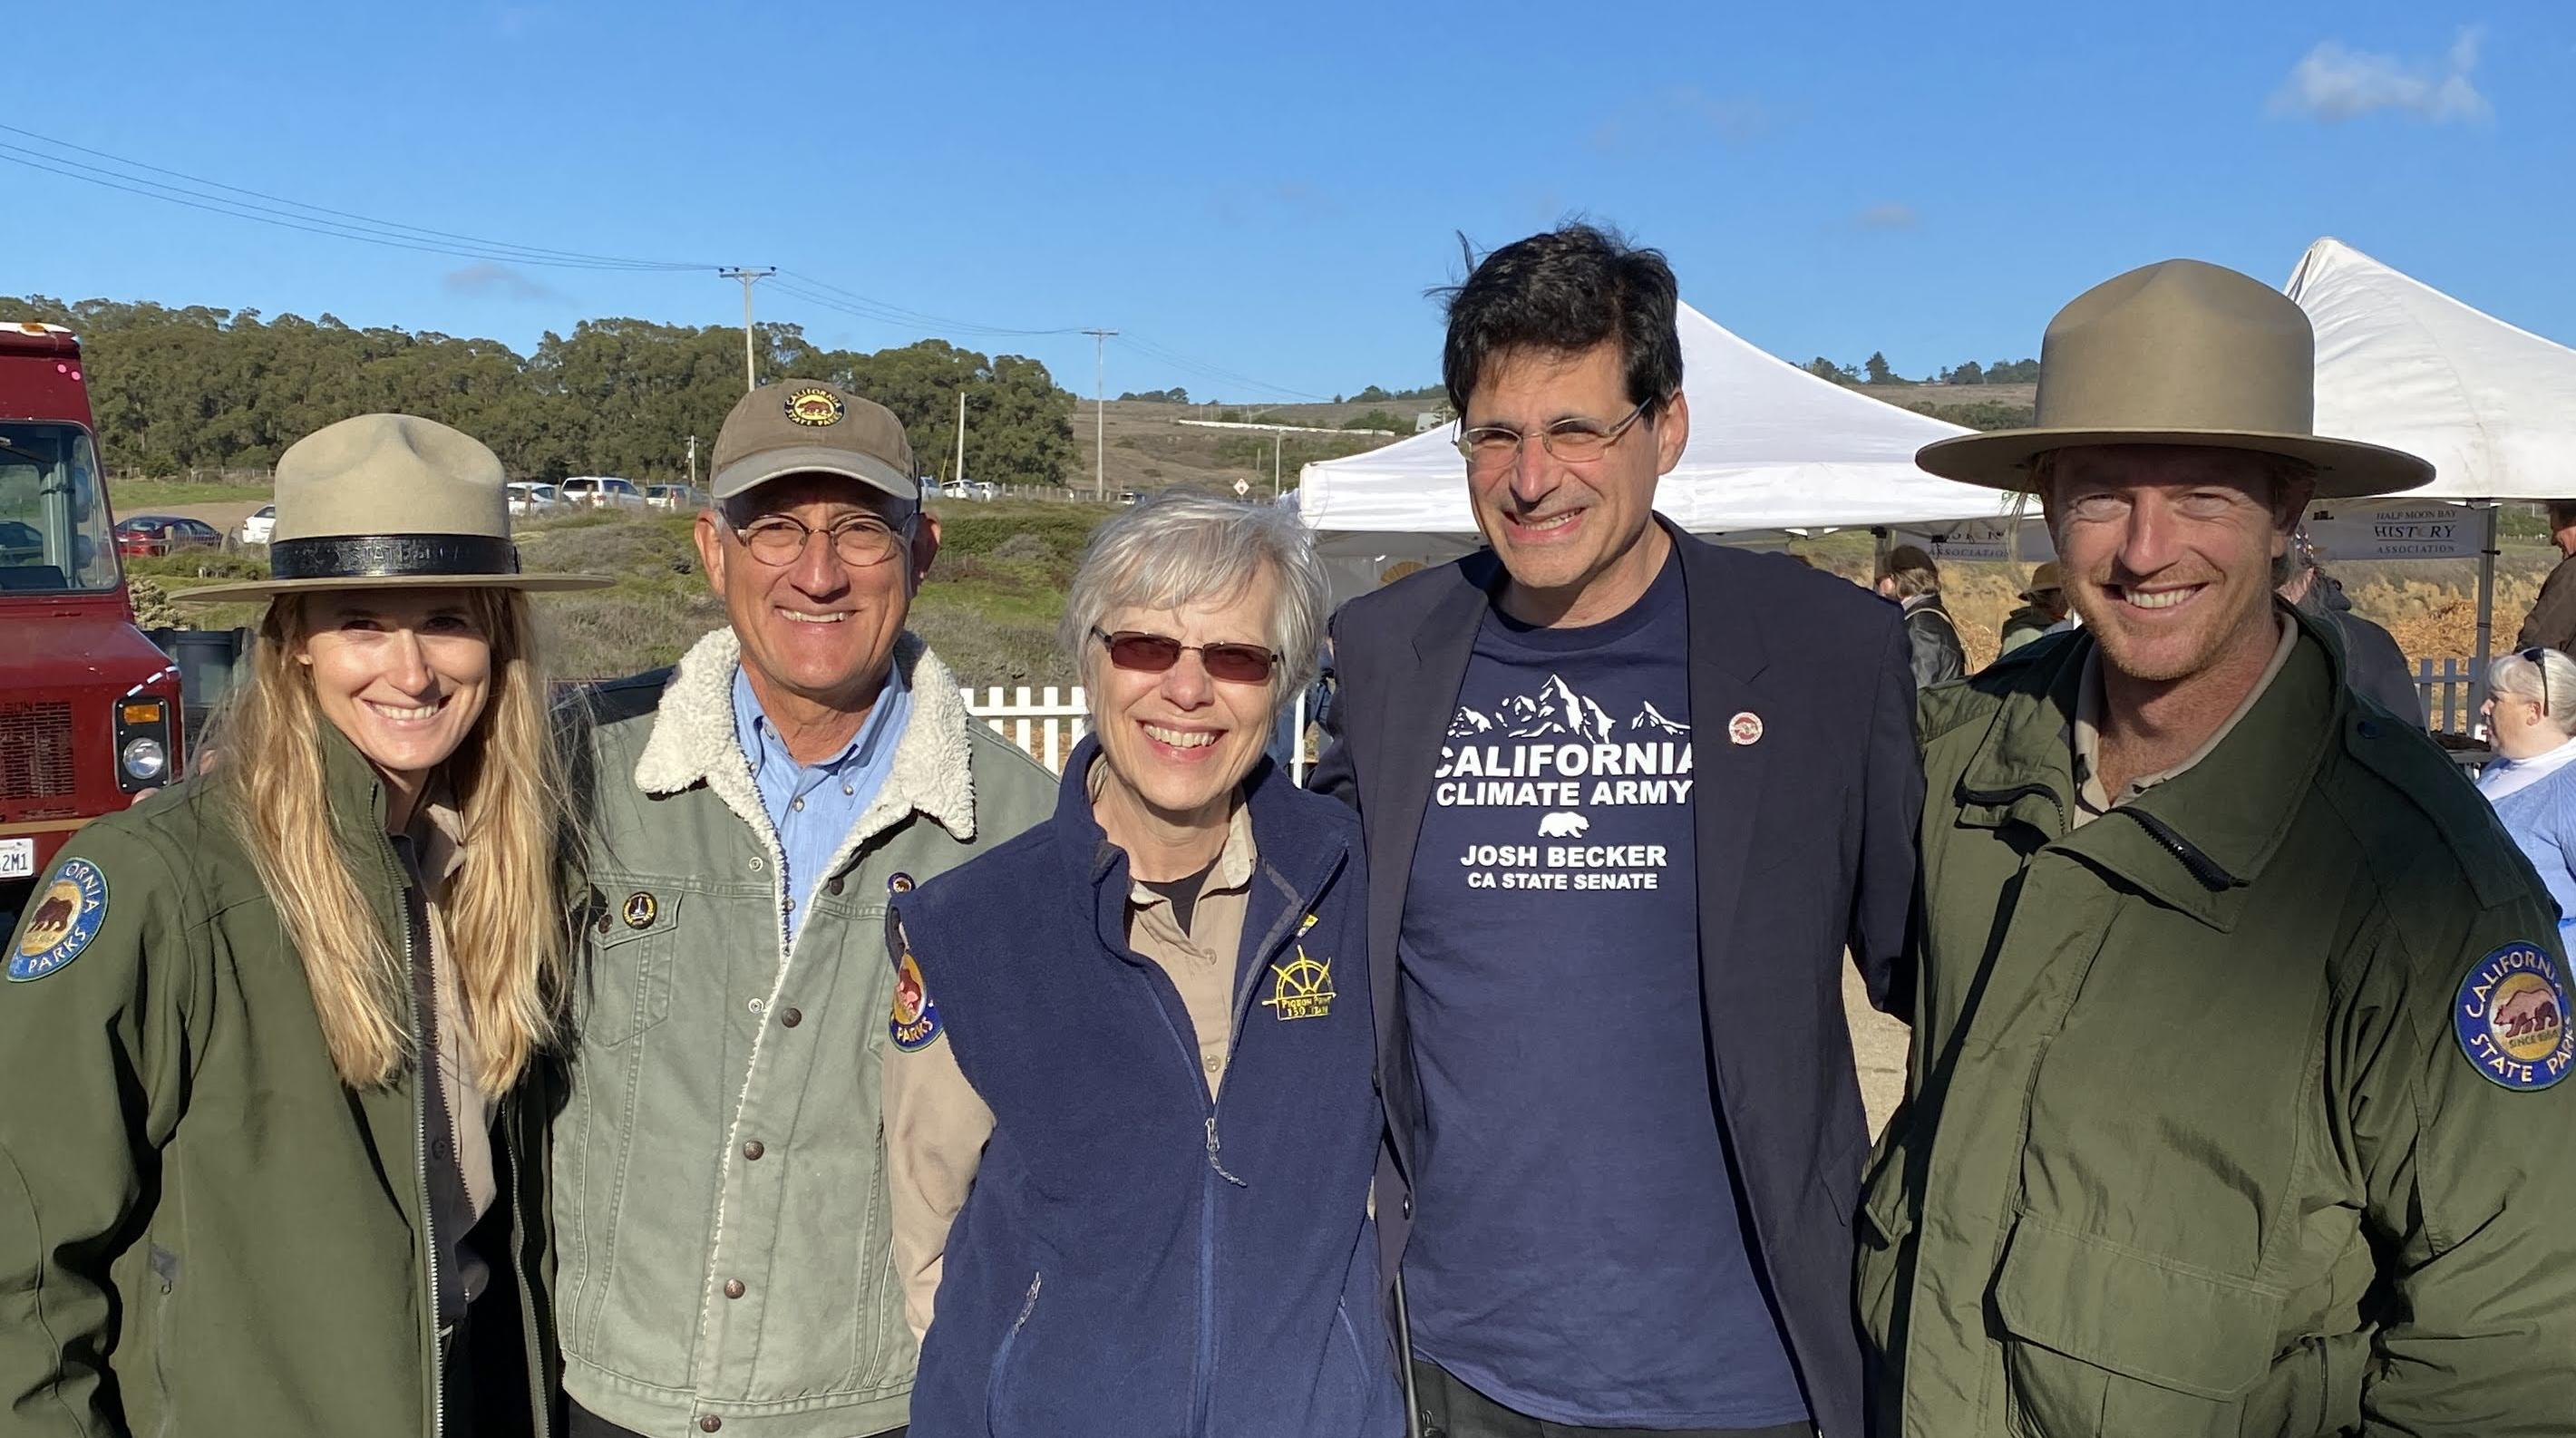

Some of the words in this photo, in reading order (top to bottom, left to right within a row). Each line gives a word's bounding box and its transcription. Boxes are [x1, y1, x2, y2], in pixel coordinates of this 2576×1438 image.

[2437, 510, 2456, 518] BAY
[2377, 544, 2454, 554] ASSOCIATION
[1436, 782, 1580, 806] CLIMATE
[1589, 780, 1694, 806] ARMY
[1460, 845, 1538, 868] JOSH
[1547, 845, 1667, 868] BECKER
[1468, 872, 1497, 889] CA
[1502, 873, 1568, 889] STATE
[1573, 872, 1658, 889] SENATE
[28, 926, 86, 974] PARKS
[897, 1016, 933, 1043] PARKS
[2509, 1035, 2537, 1049] SINCE
[2470, 1034, 2533, 1083] STATE
